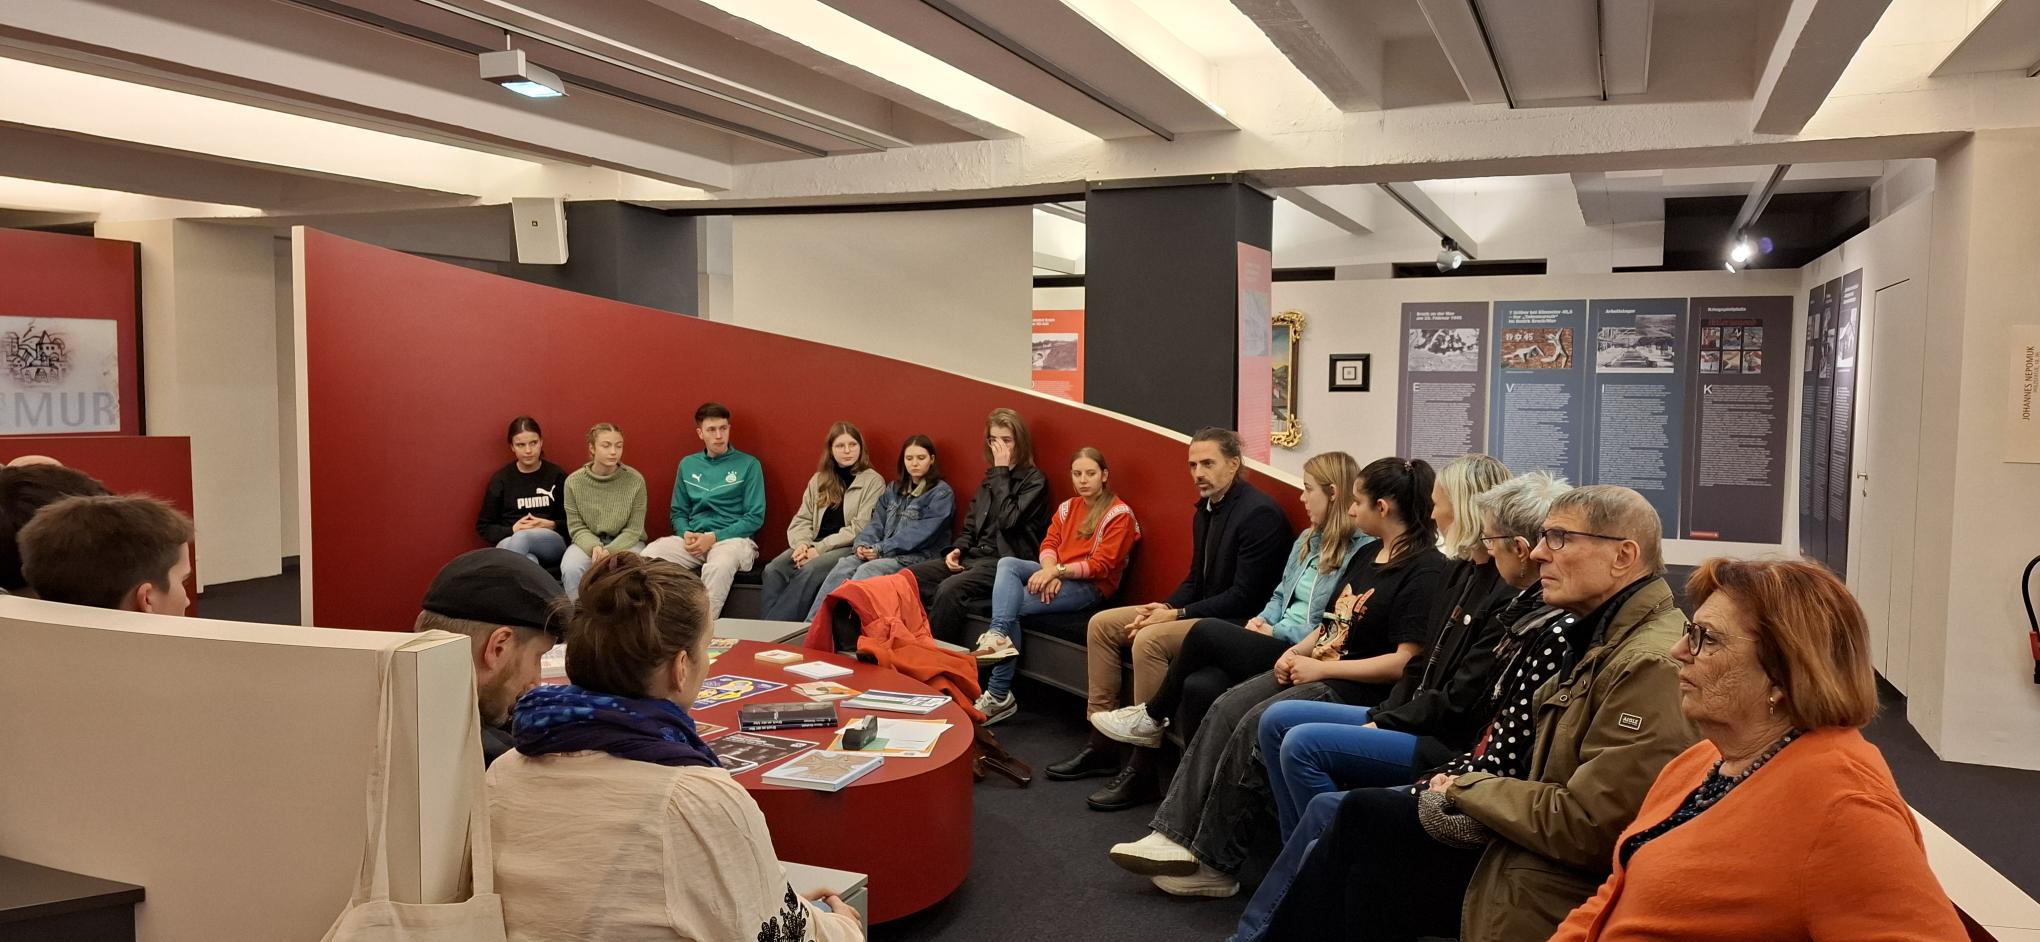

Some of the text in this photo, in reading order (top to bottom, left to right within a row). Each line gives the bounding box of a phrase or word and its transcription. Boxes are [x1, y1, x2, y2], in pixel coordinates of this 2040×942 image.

[1523, 332, 1534, 341] 45
[2022, 346, 2035, 421] JOHANNES NEPOMUK
[0, 392, 117, 427] MUR
[517, 496, 550, 509] PUMA
